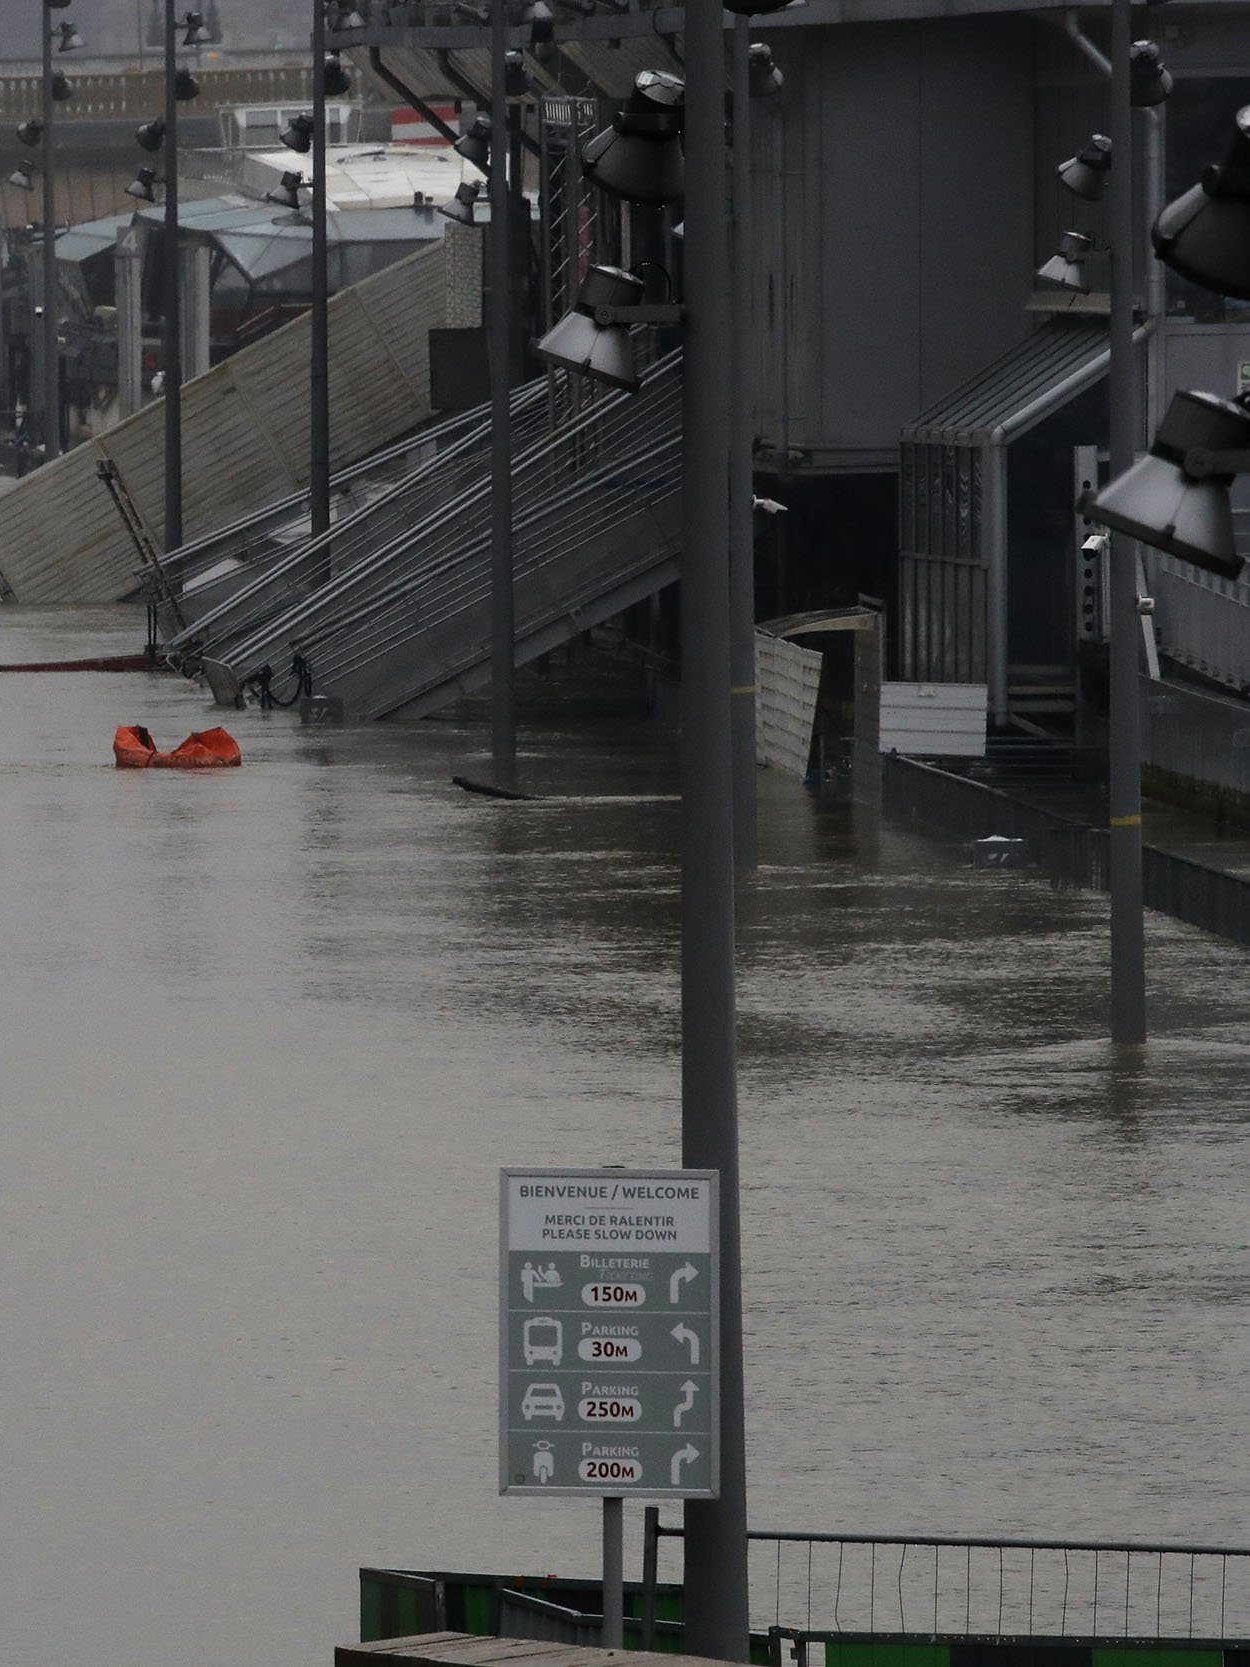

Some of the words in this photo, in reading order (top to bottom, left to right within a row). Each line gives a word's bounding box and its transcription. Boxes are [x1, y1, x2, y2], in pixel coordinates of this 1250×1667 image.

[121, 230, 138, 252] 4
[520, 1185, 607, 1198] BIENVENUE
[611, 1185, 619, 1200] /
[622, 1186, 700, 1200] WELCOME
[544, 1215, 585, 1226] MERCI
[589, 1215, 605, 1226] DE
[609, 1215, 674, 1227] RALENTIR
[542, 1229, 590, 1240] PLEASE
[593, 1229, 631, 1240] SLOW
[635, 1229, 677, 1241] DOWN
[580, 1254, 650, 1269] BILLETERIE
[581, 1322, 639, 1336] PARKING
[581, 1381, 639, 1396] PARKING
[582, 1442, 639, 1457] PARKING
